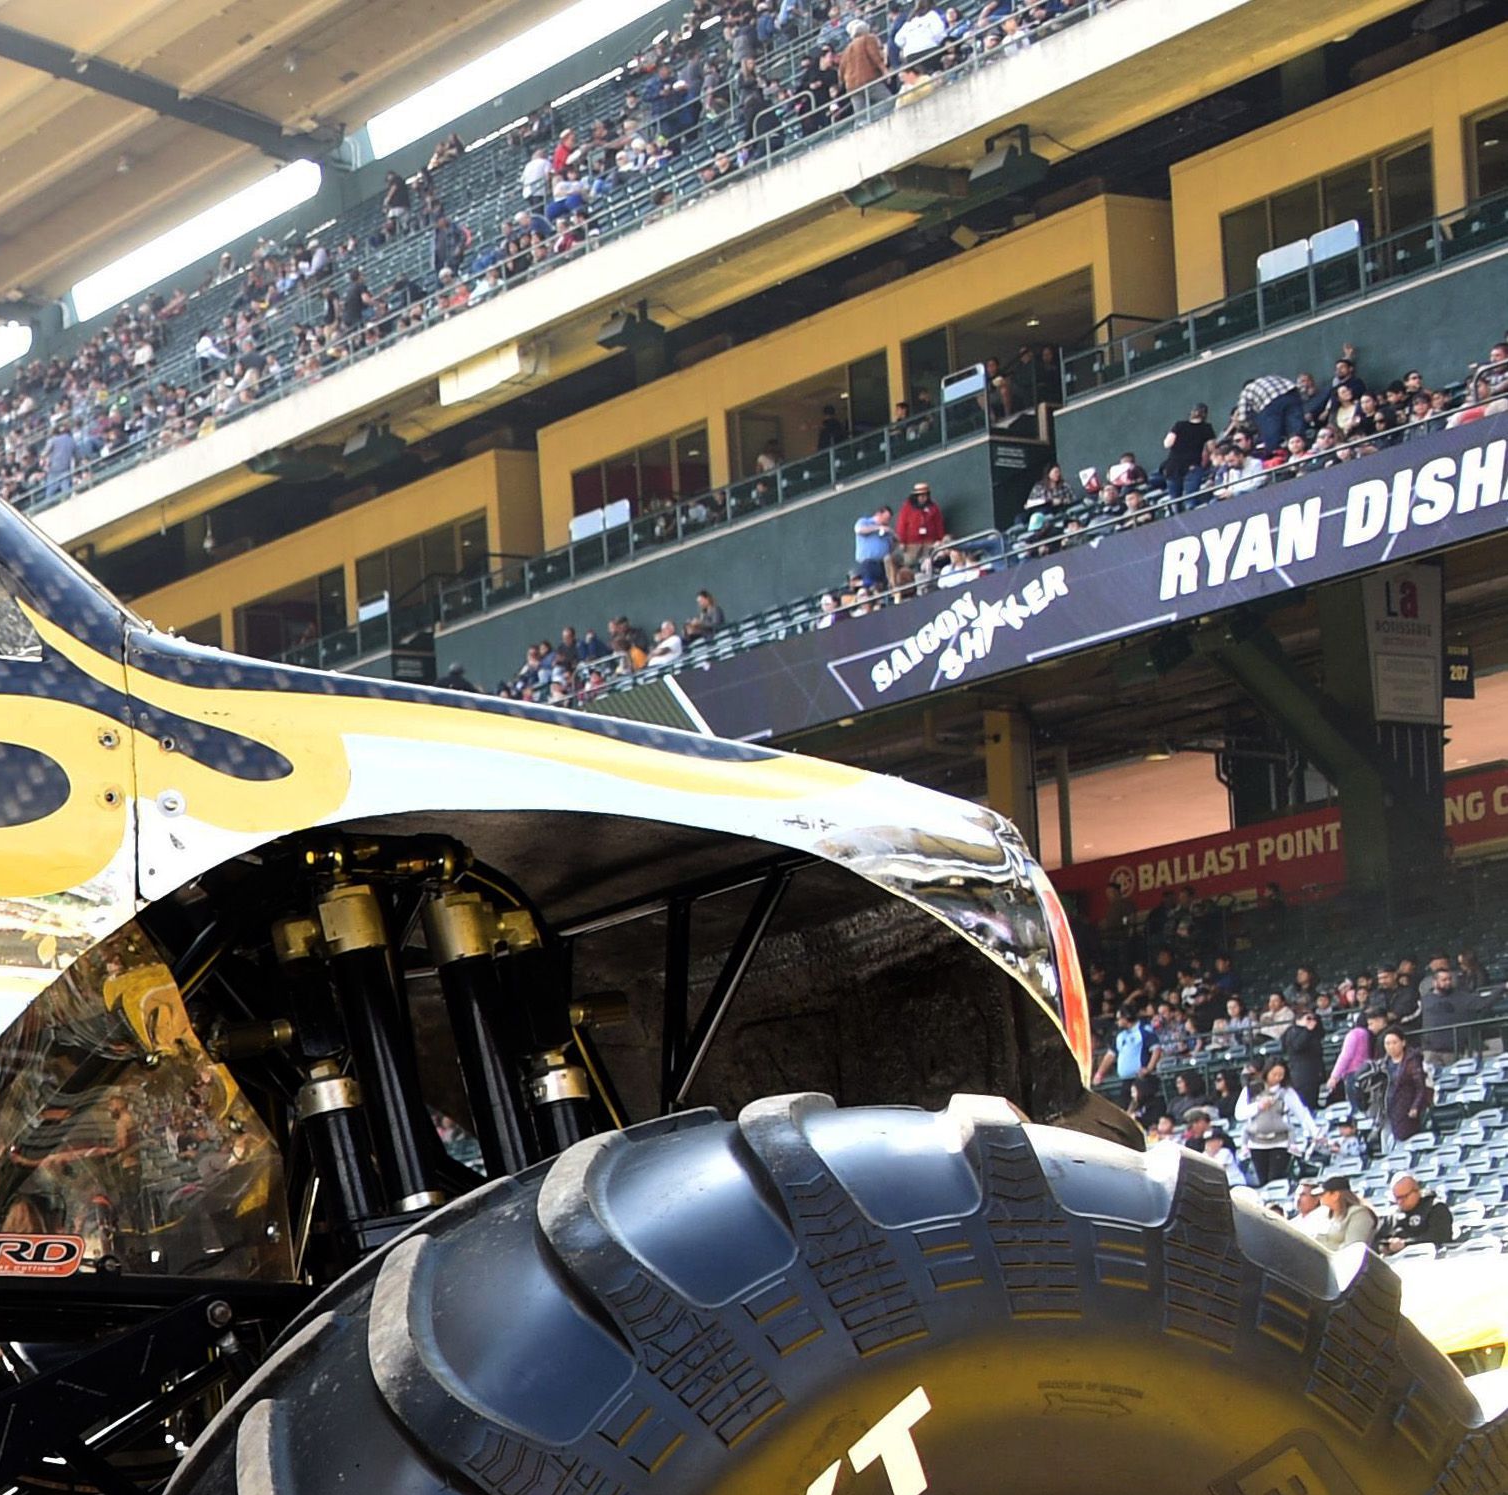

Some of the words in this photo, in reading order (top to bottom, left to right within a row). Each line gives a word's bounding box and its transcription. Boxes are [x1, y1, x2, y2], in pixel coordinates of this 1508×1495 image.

[1160, 497, 1322, 602] RYAN
[1343, 439, 1508, 547] DISH
[871, 591, 979, 692] SAIGON
[1444, 790, 1485, 827] NG
[1138, 842, 1251, 892] BALLAST
[1257, 822, 1341, 866] POINT
